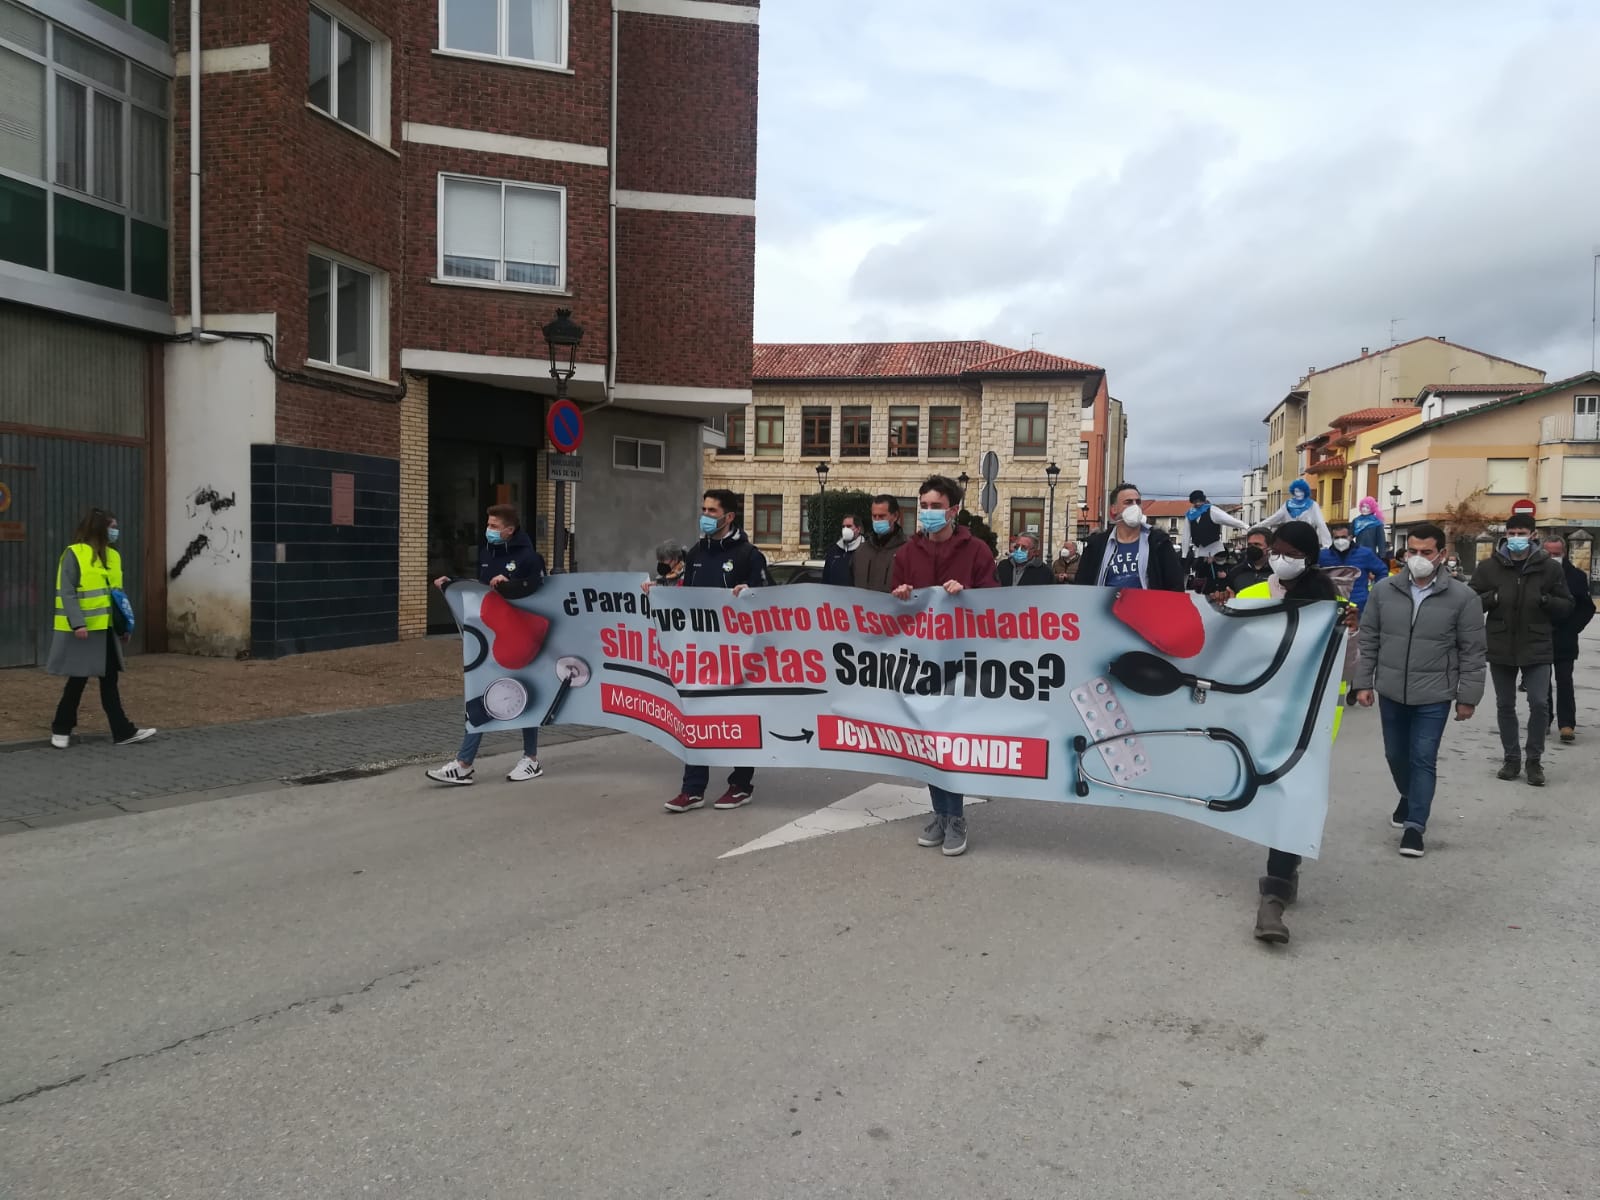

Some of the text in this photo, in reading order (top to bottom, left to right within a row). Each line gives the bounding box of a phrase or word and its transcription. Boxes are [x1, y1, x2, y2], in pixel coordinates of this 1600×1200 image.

[1112, 562, 1137, 575] RAC
[691, 608, 720, 632] un
[723, 605, 811, 636] Centro
[816, 602, 850, 632] de
[853, 604, 1081, 642] Especialidades
[600, 623, 643, 662] sin
[832, 642, 1066, 702] Sanitarios?
[611, 688, 674, 728] Merindades
[836, 720, 1023, 770] JCyL NO RESPONDE
